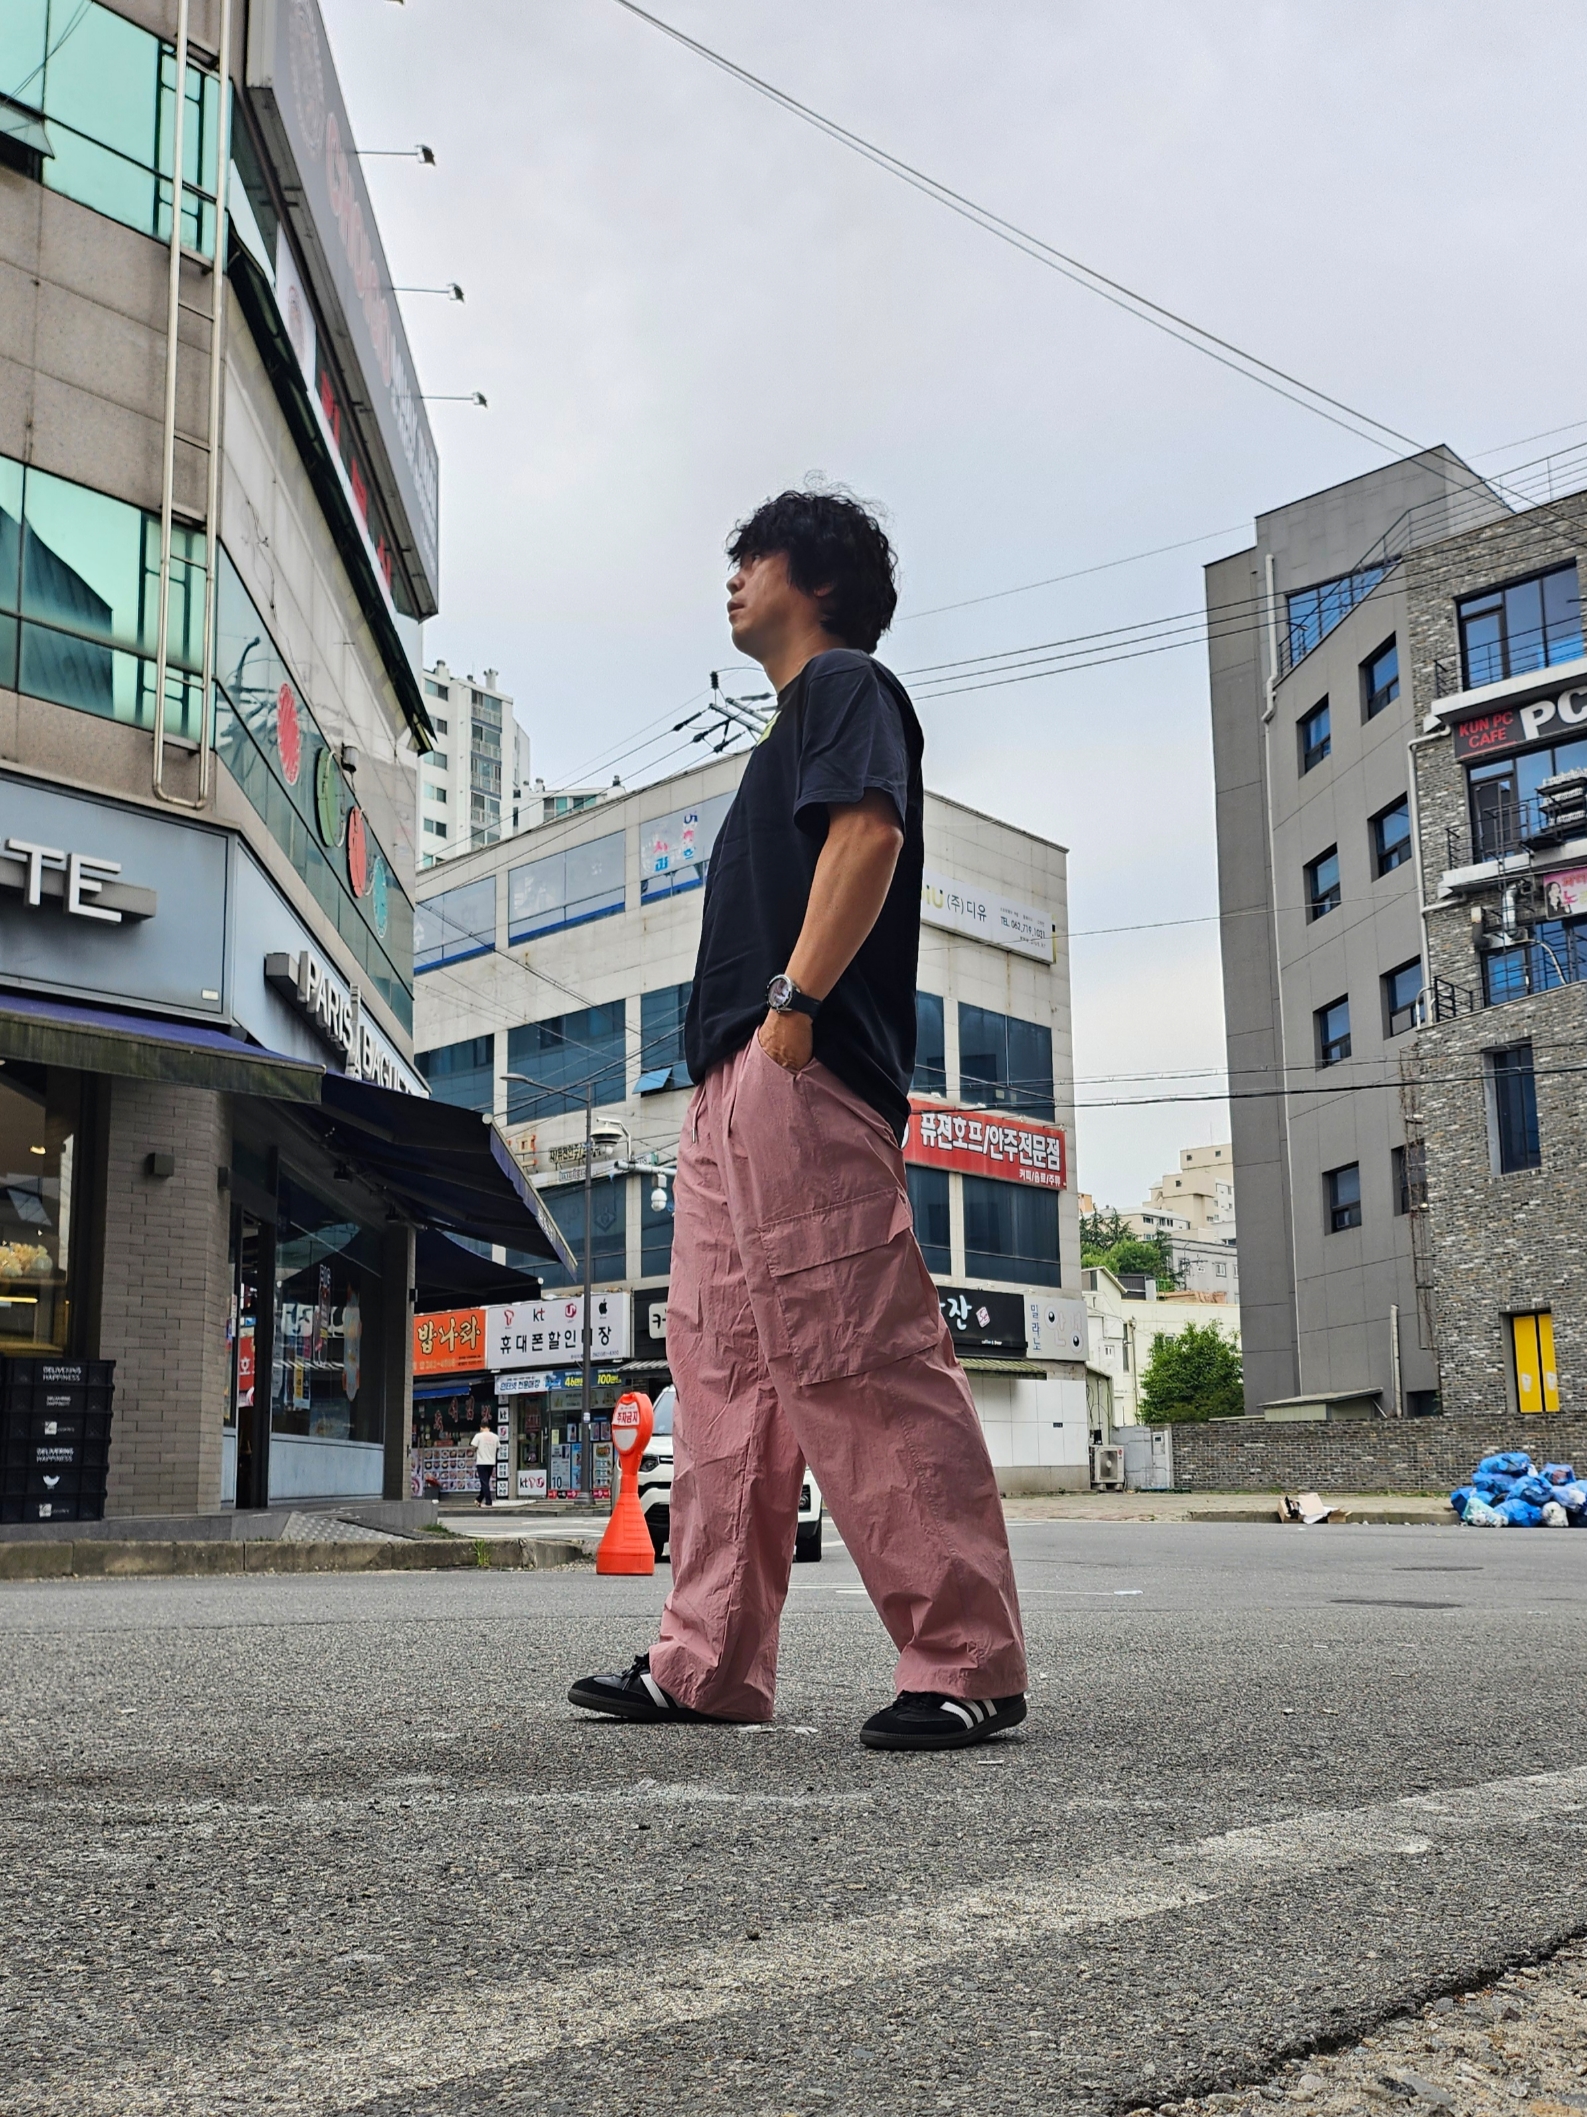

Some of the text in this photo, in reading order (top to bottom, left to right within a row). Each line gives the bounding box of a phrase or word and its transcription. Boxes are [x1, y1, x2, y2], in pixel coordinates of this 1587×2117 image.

[1459, 711, 1514, 738] KUN PC
[1468, 727, 1507, 748] CAFE
[300, 950, 354, 1051] PARIS
[533, 1307, 545, 1321] kt
[940, 1294, 972, 1330] 잔
[417, 1314, 481, 1355] 밥나라
[519, 1477, 528, 1488] kt
